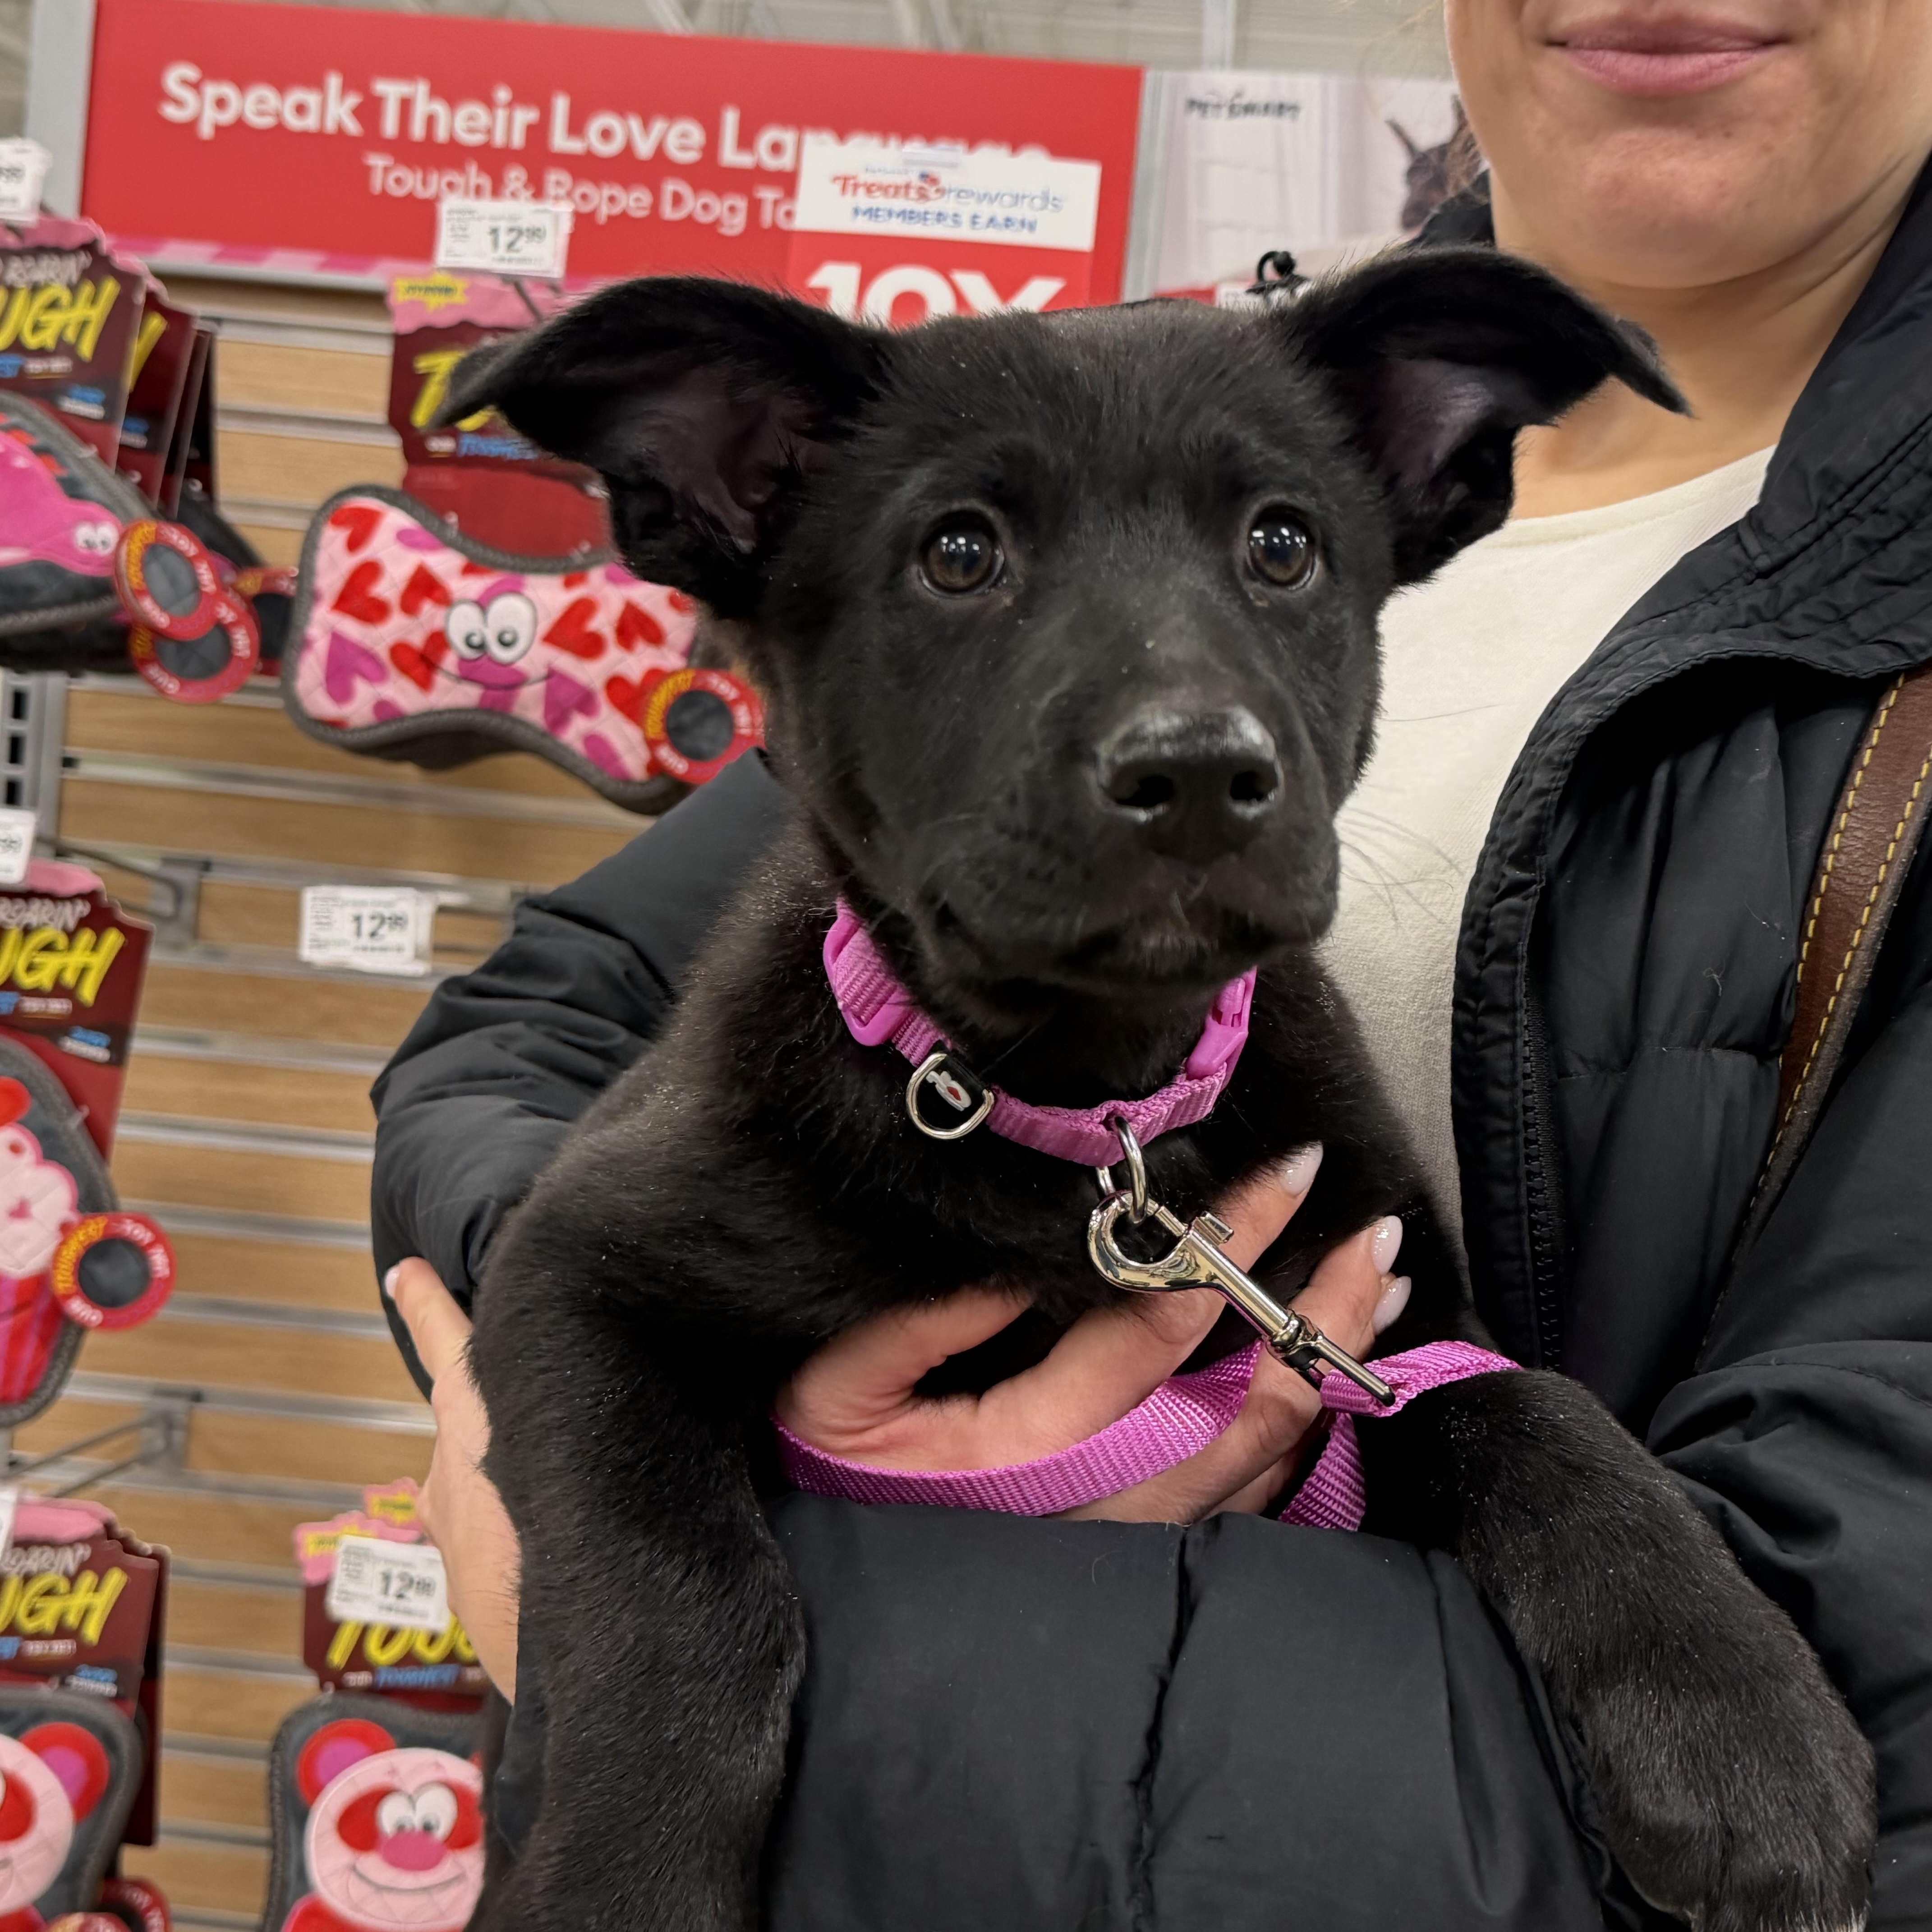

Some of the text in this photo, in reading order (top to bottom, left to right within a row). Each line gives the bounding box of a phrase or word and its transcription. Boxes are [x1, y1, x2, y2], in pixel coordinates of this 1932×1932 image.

[158, 61, 363, 140] Speak
[370, 78, 540, 150] Their
[550, 91, 706, 162] Love
[363, 151, 493, 201] Tough
[501, 161, 536, 202] &
[543, 166, 652, 225] Rope
[660, 179, 749, 237] Dog
[851, 204, 1038, 235] MEMBERS EARN
[944, 186, 1065, 213] rewards
